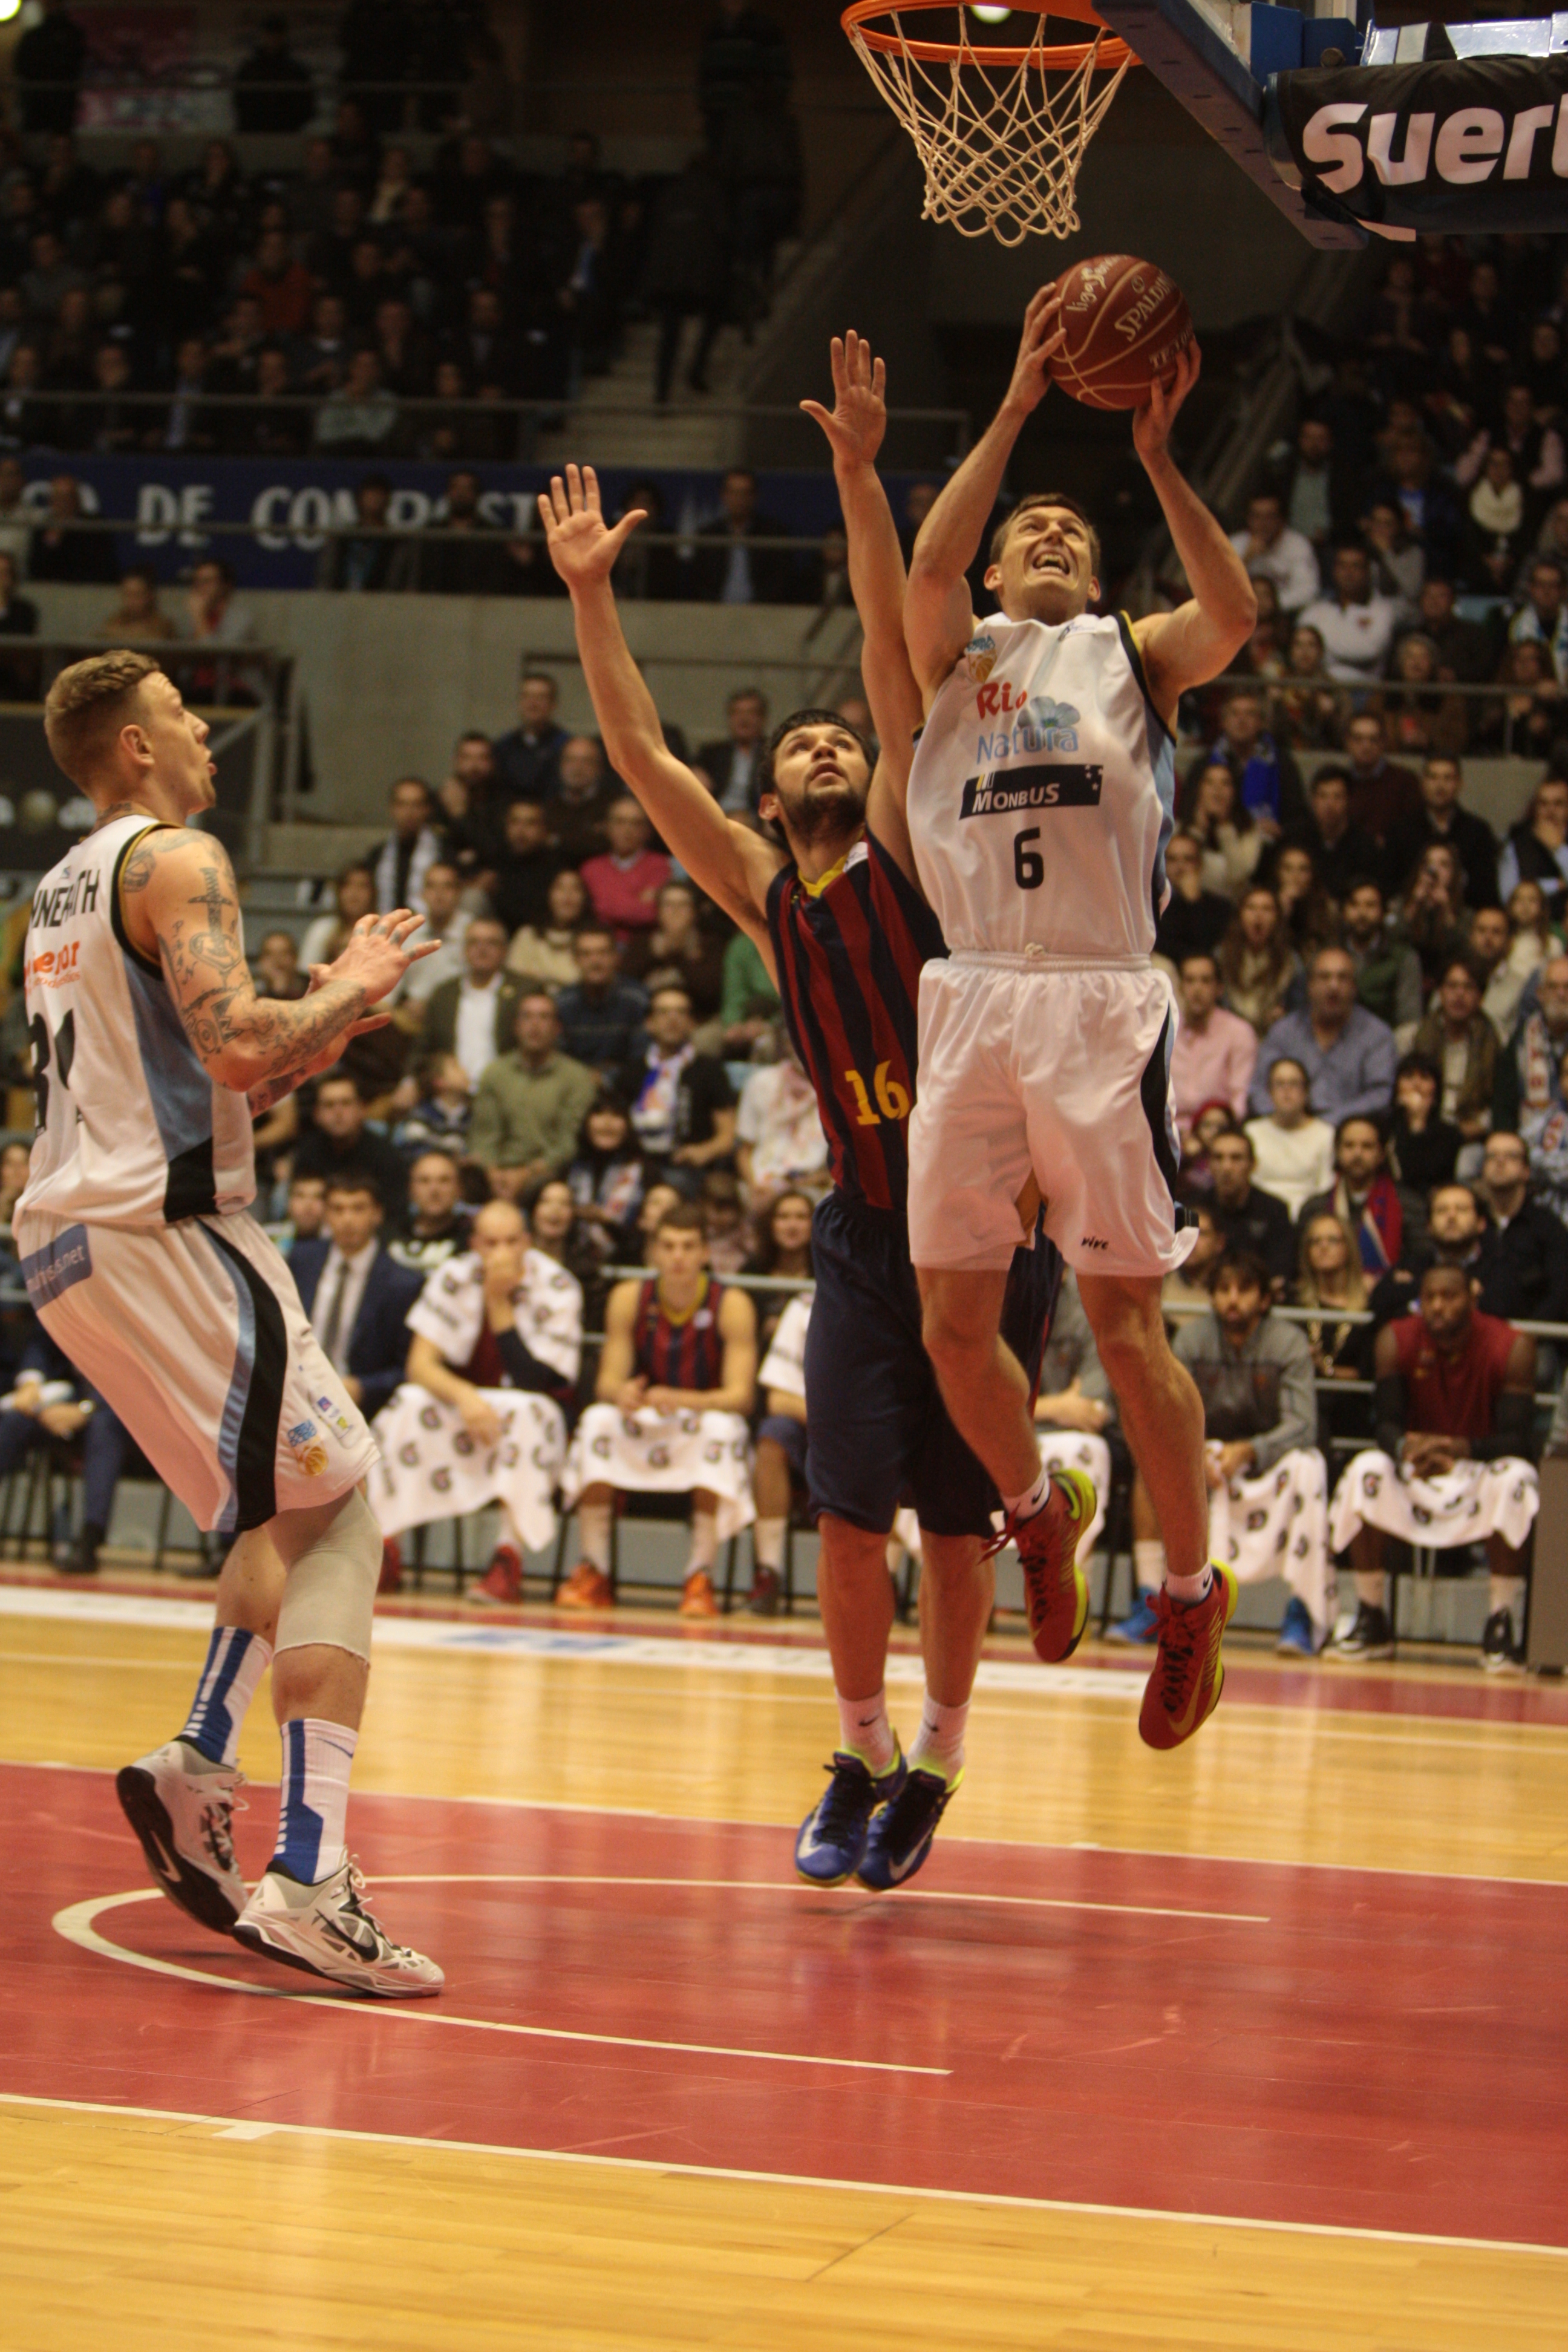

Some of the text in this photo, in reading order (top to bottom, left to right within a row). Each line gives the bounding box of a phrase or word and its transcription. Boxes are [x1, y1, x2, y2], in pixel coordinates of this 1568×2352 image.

[1114, 269, 1175, 343] SPALDIN
[136, 483, 215, 547] DE
[976, 682, 1027, 719] Rio
[976, 726, 1079, 765] Natura
[972, 783, 1060, 814] MONBUS
[1013, 826, 1045, 890] 6
[844, 1060, 909, 1126] 16
